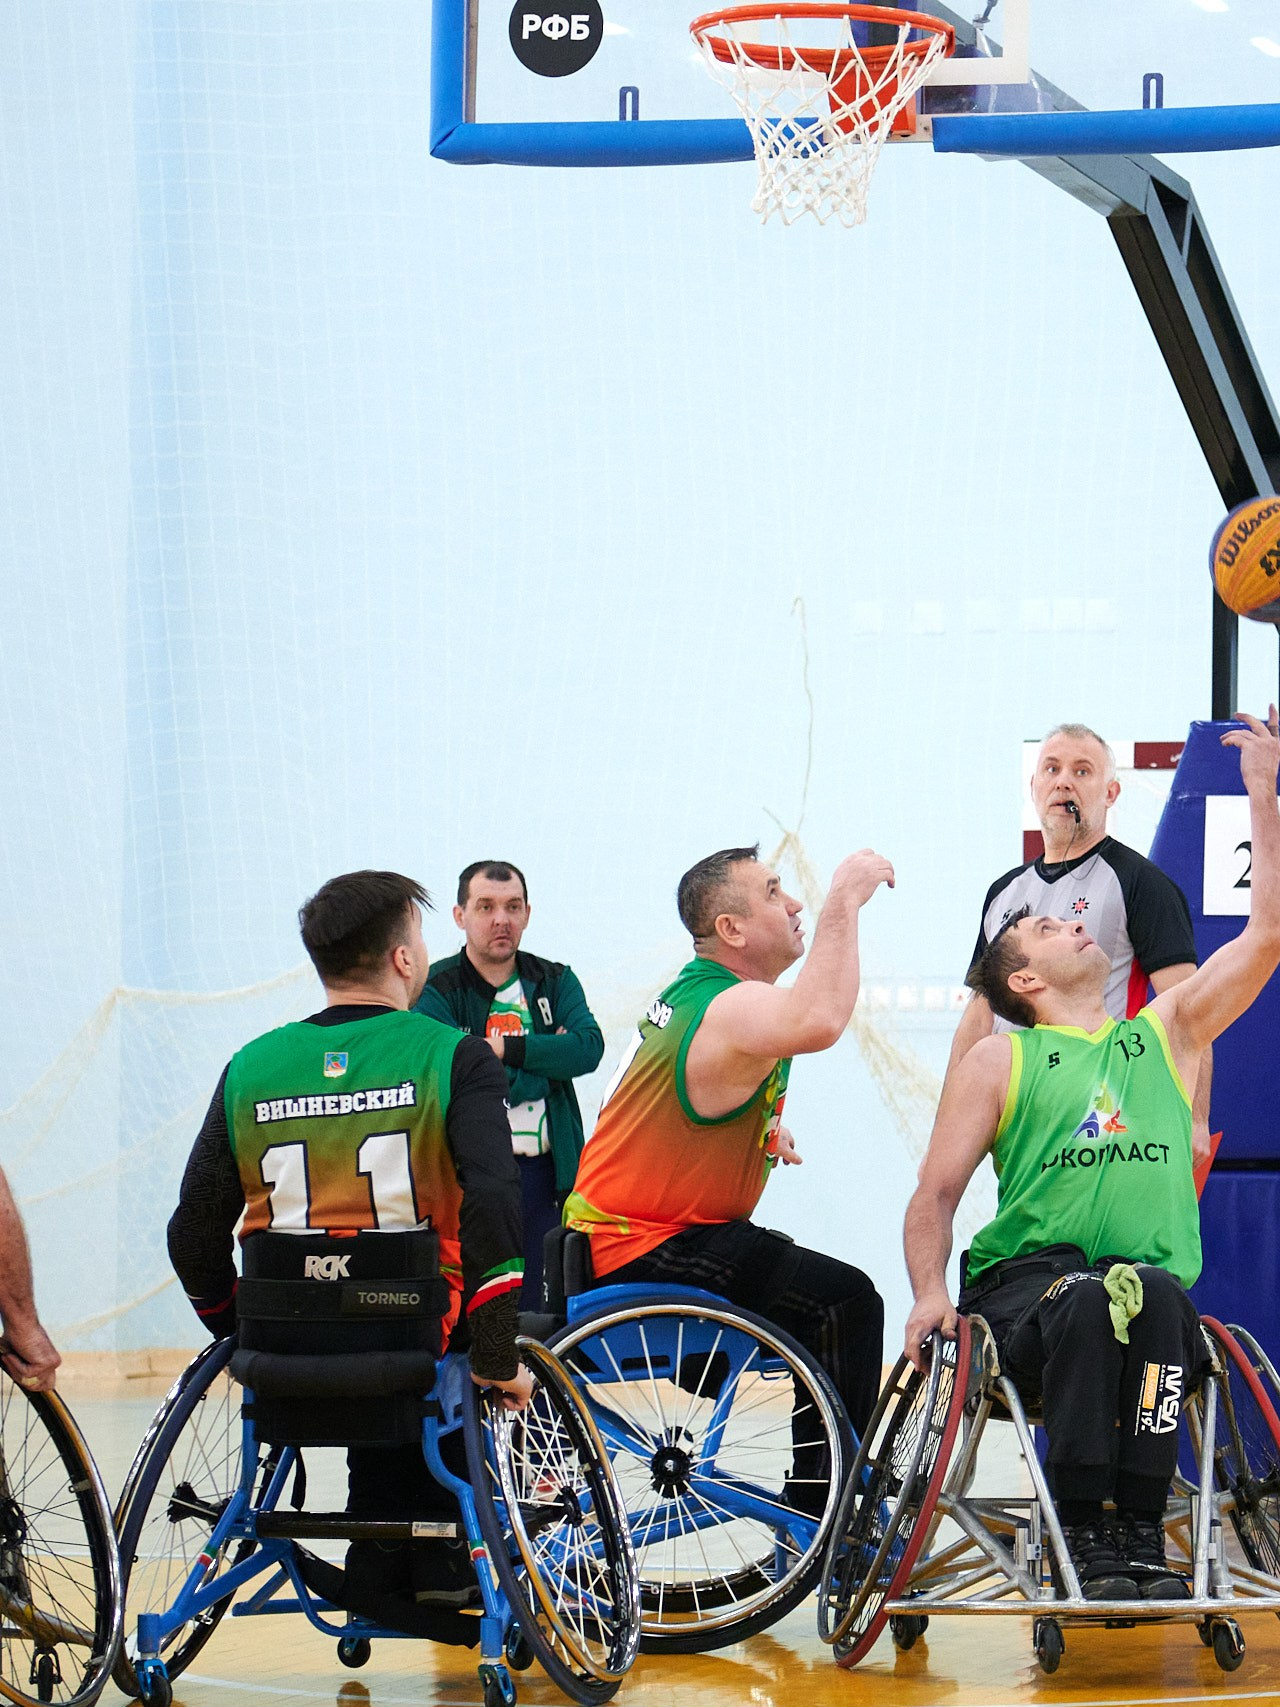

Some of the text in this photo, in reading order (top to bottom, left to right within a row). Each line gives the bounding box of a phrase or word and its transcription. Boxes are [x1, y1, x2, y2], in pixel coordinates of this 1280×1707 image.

[522, 13, 590, 41] РФБ
[1232, 840, 1252, 889] 2
[1115, 1032, 1146, 1062] 13
[255, 1081, 416, 1123] ВИШНЕВСКИЙ
[260, 1132, 430, 1235] 11
[358, 1291, 420, 1305] TORNEO
[1159, 1365, 1182, 1434] NASA
